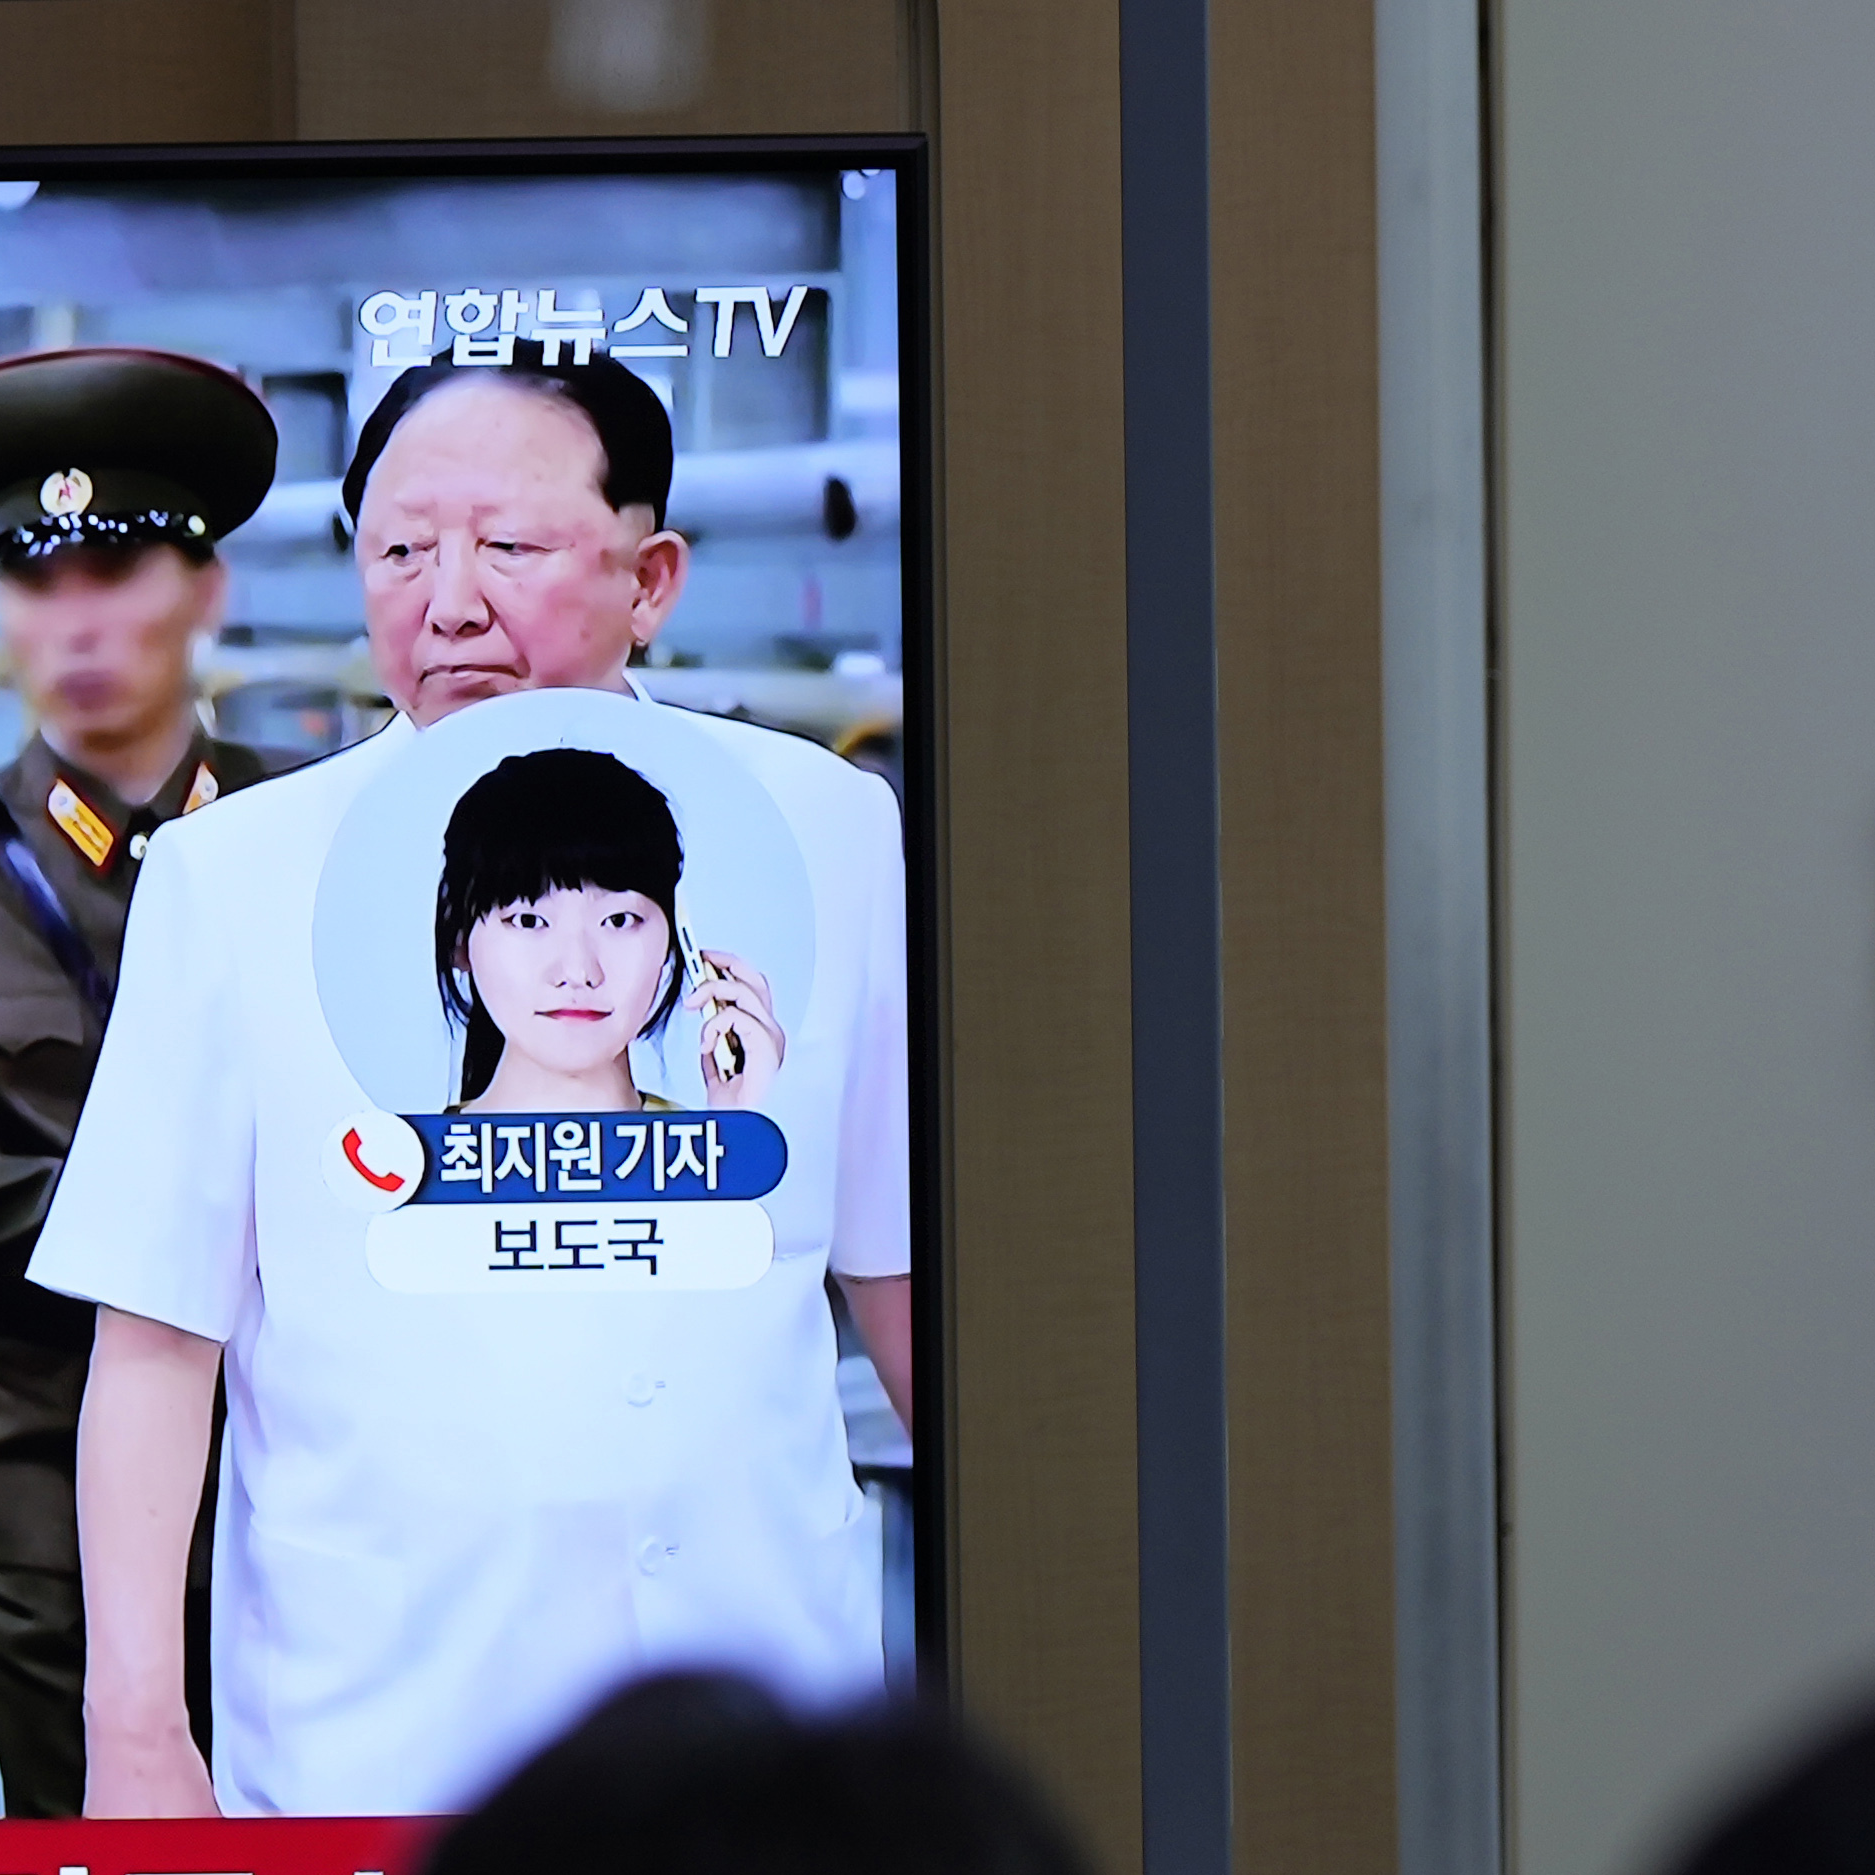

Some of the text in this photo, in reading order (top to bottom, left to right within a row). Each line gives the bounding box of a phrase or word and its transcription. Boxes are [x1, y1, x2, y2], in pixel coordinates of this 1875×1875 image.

[358, 286, 807, 367] 연합뉴스TV
[440, 1120, 725, 1194] 최지원 기자
[487, 1217, 666, 1277] 보도국
